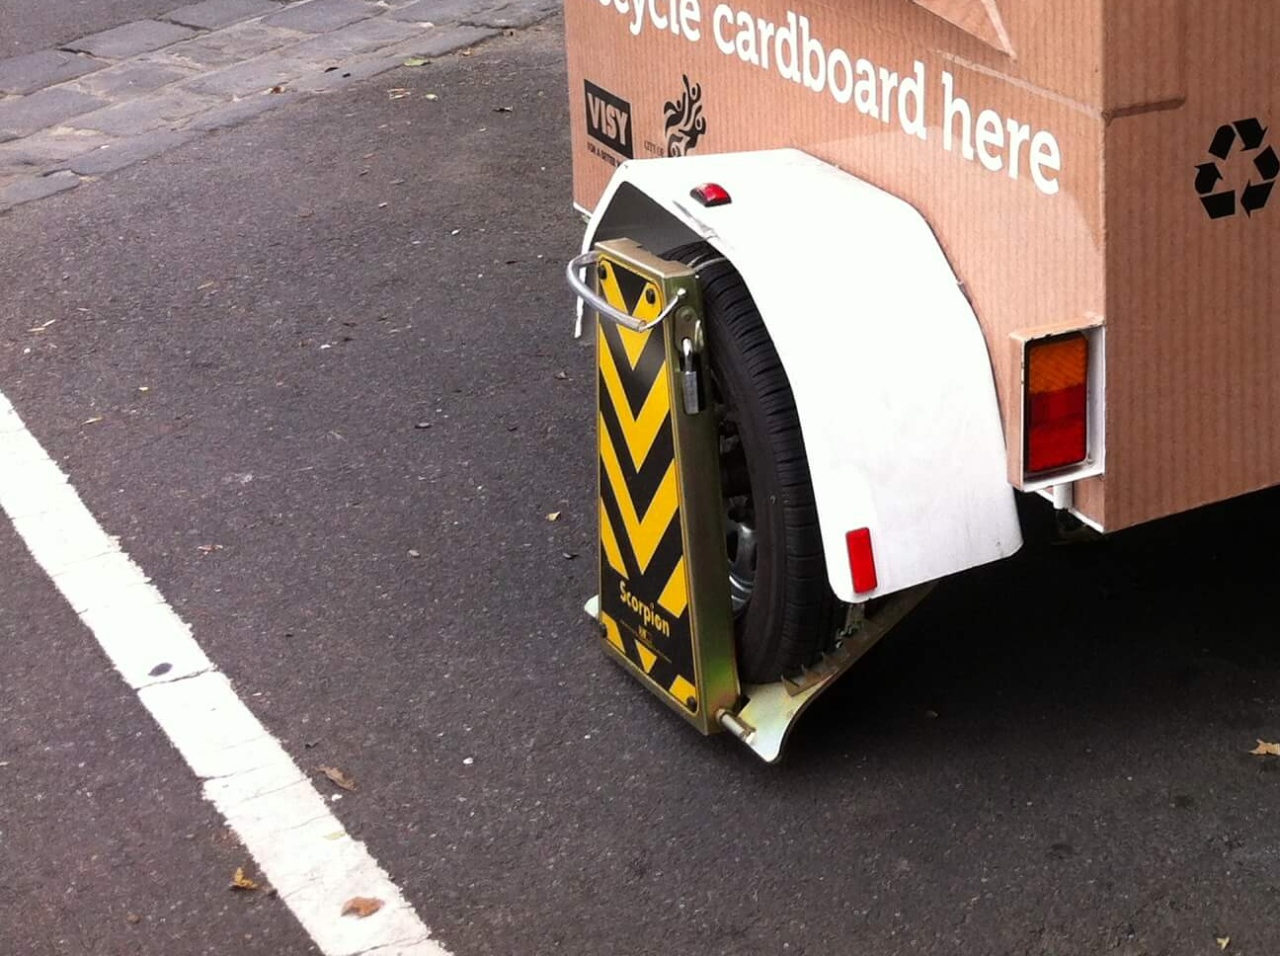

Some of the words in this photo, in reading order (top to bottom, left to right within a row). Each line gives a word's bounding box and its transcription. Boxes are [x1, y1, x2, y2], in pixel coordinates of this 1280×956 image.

[588, 93, 628, 146] VISY
[712, 2, 928, 141] cardboard
[942, 71, 1062, 196] here
[620, 580, 670, 638] Scorpion
